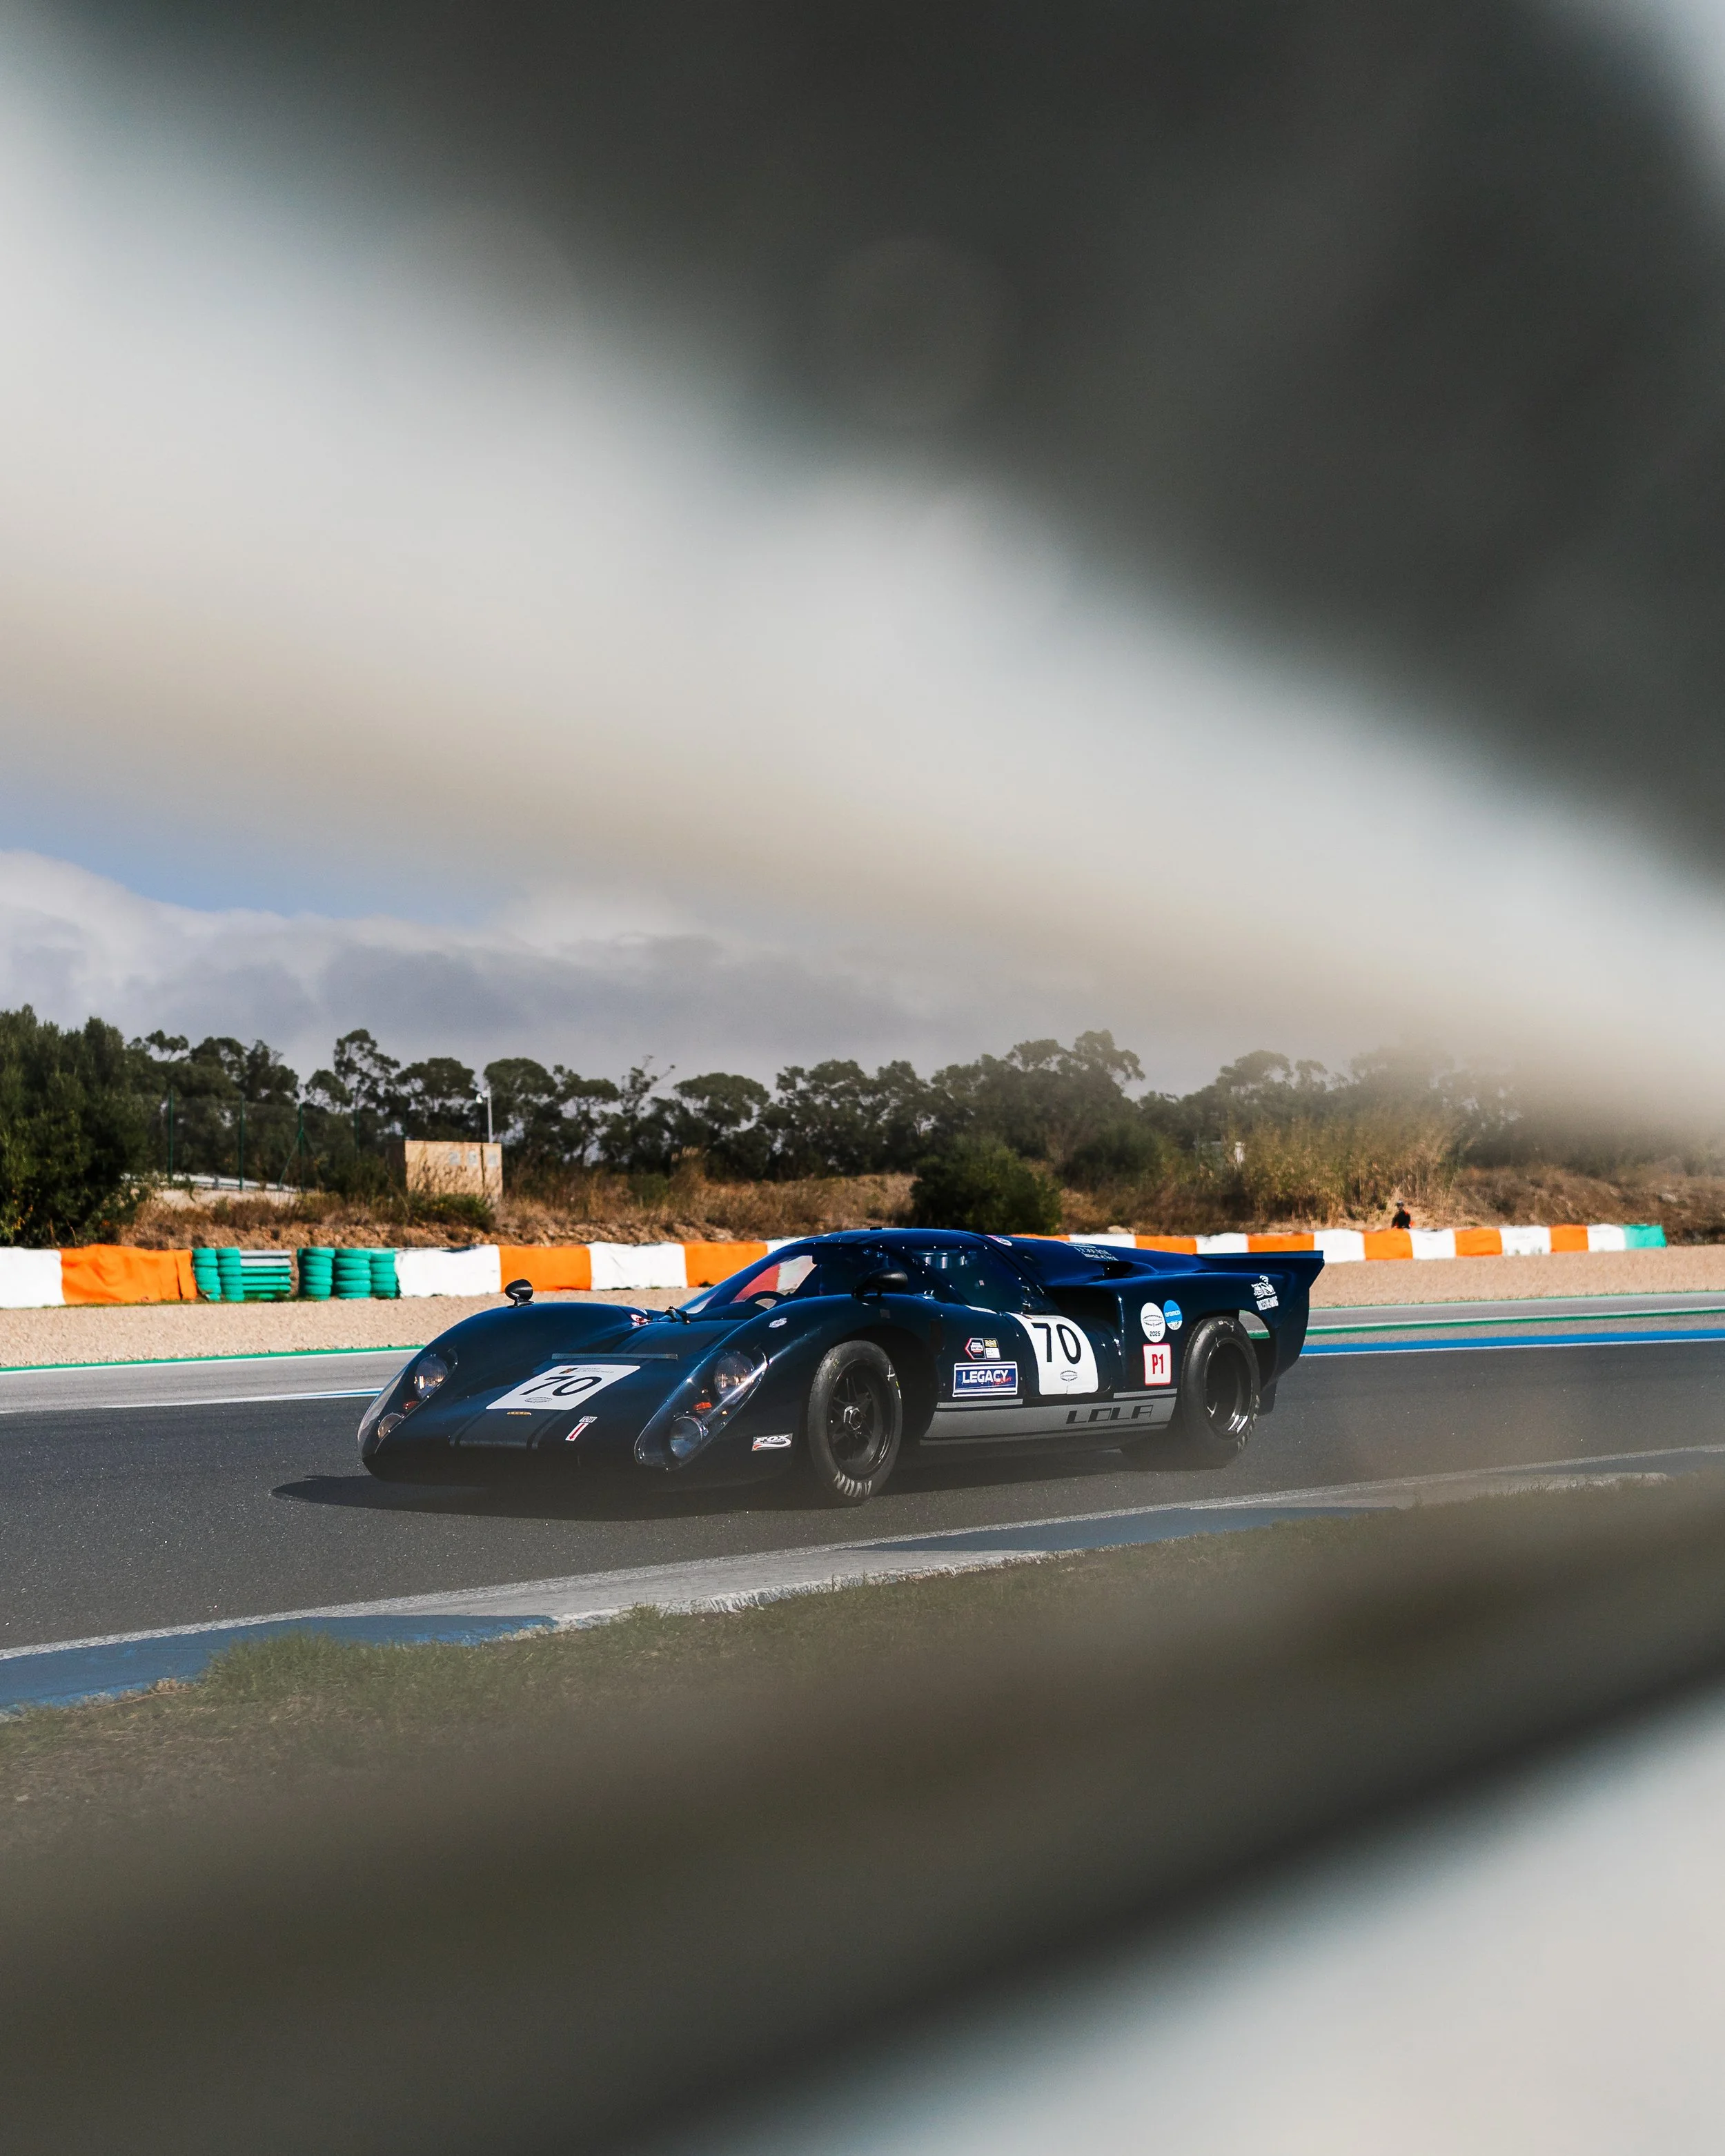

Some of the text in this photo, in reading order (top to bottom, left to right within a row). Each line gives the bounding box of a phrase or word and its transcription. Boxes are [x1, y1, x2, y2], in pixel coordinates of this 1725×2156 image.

[1030, 1322, 1081, 1364] 70
[1152, 1354, 1163, 1374] P1
[519, 1376, 602, 1396] 70
[962, 1369, 1009, 1384] LEGACY
[1065, 1404, 1154, 1424] LOLA
[754, 1435, 789, 1444] FOX
